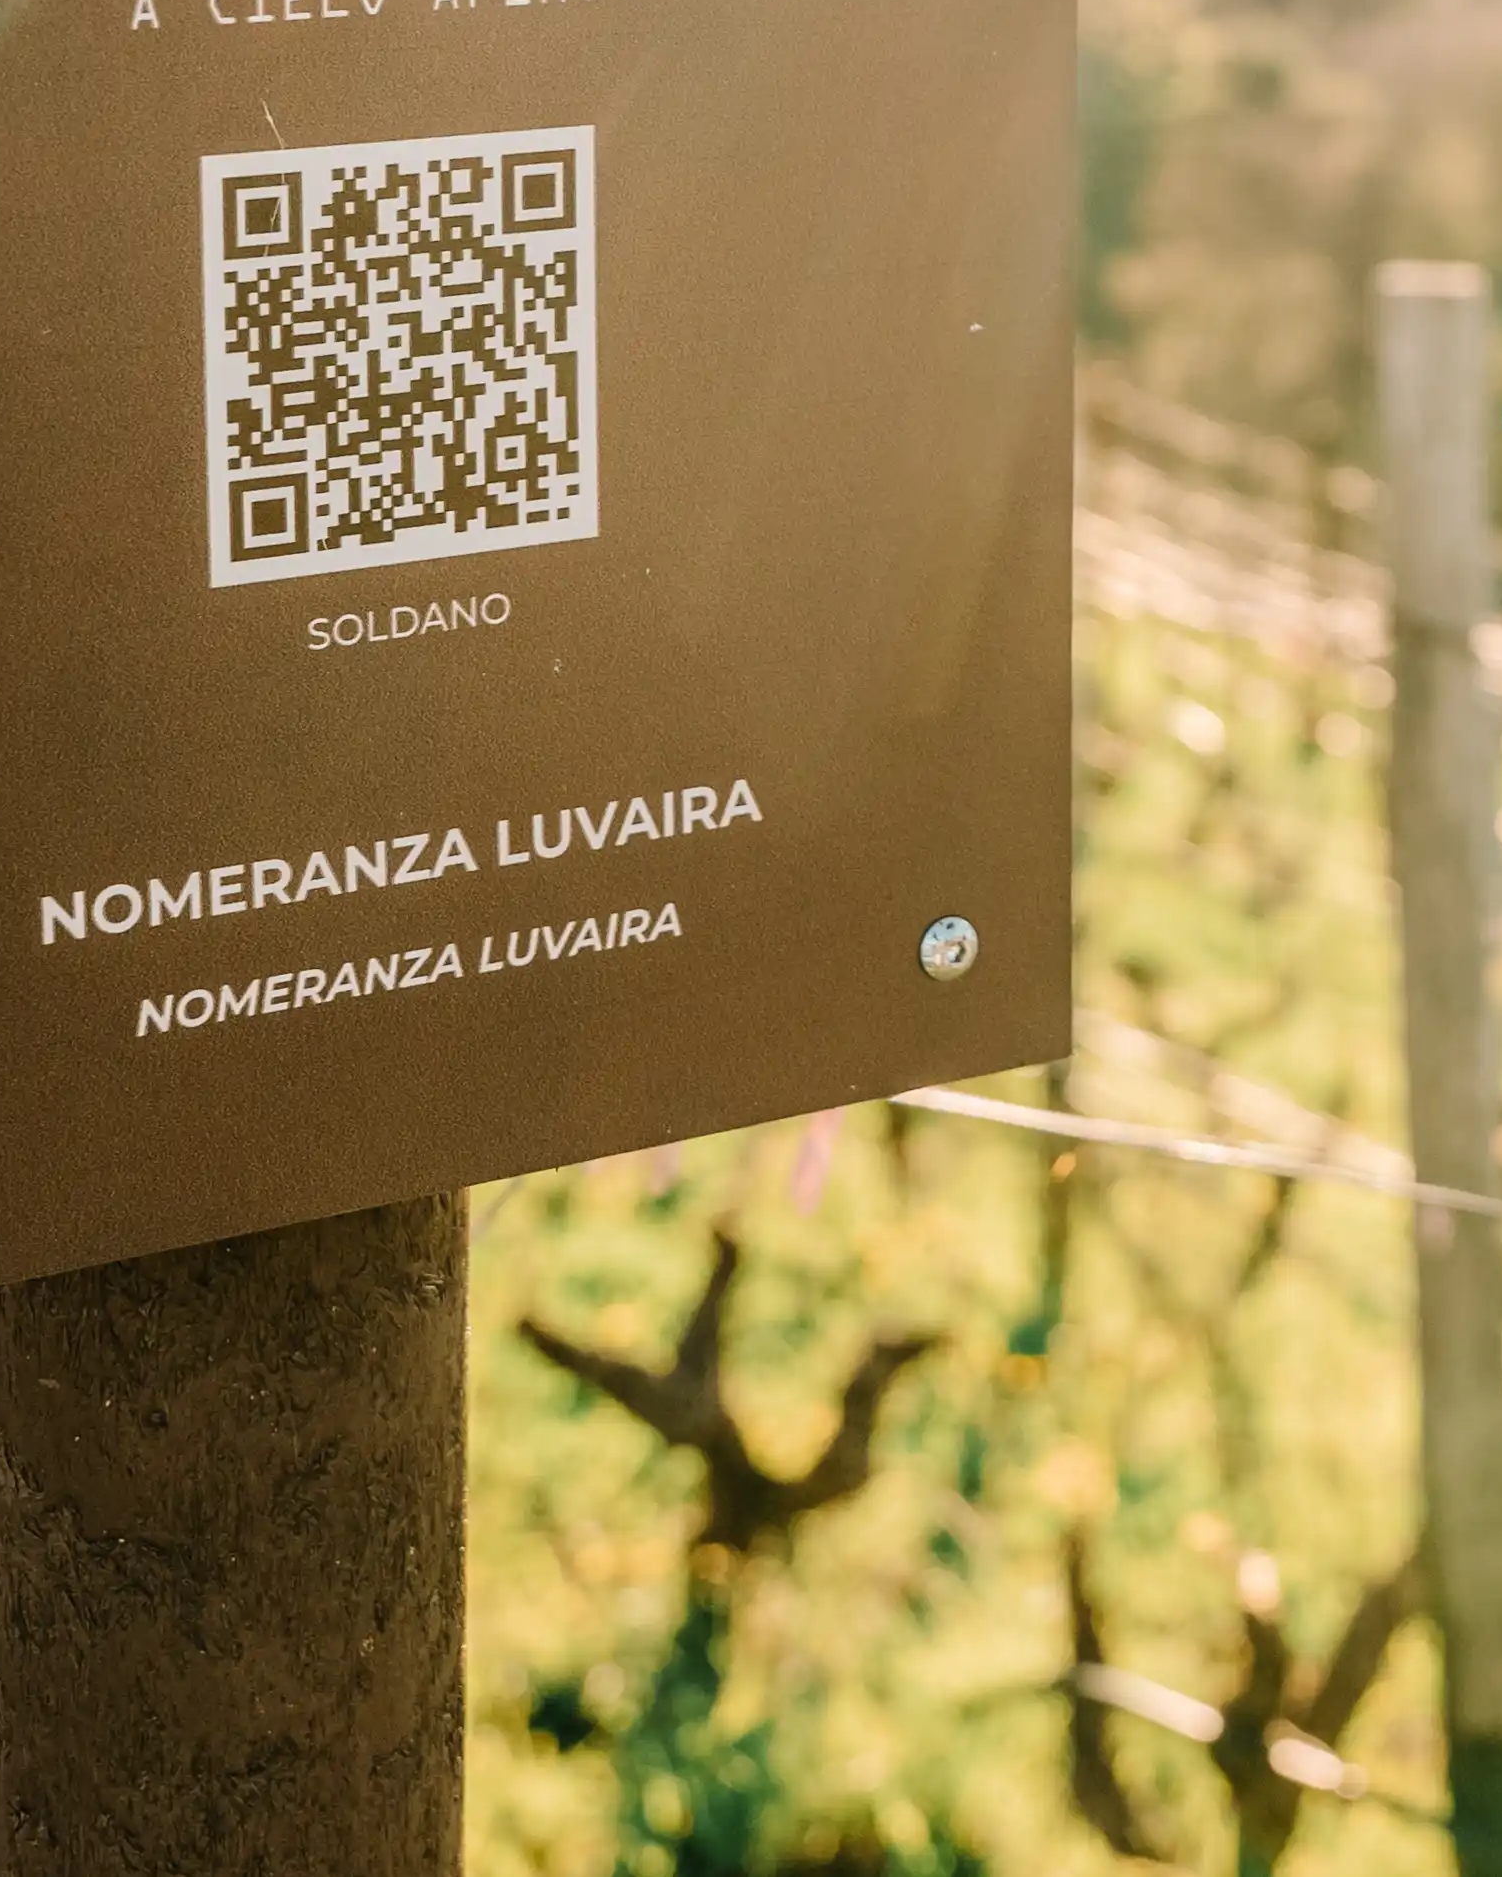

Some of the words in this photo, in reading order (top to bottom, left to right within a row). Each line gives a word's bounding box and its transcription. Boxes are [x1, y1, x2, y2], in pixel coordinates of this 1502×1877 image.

[308, 593, 510, 650] SOLDANO
[40, 828, 479, 945] NOMERANZA
[497, 779, 763, 866] LUVAIRA
[136, 943, 464, 1037] NOMERANZA
[478, 903, 682, 973] LUVAIRA
